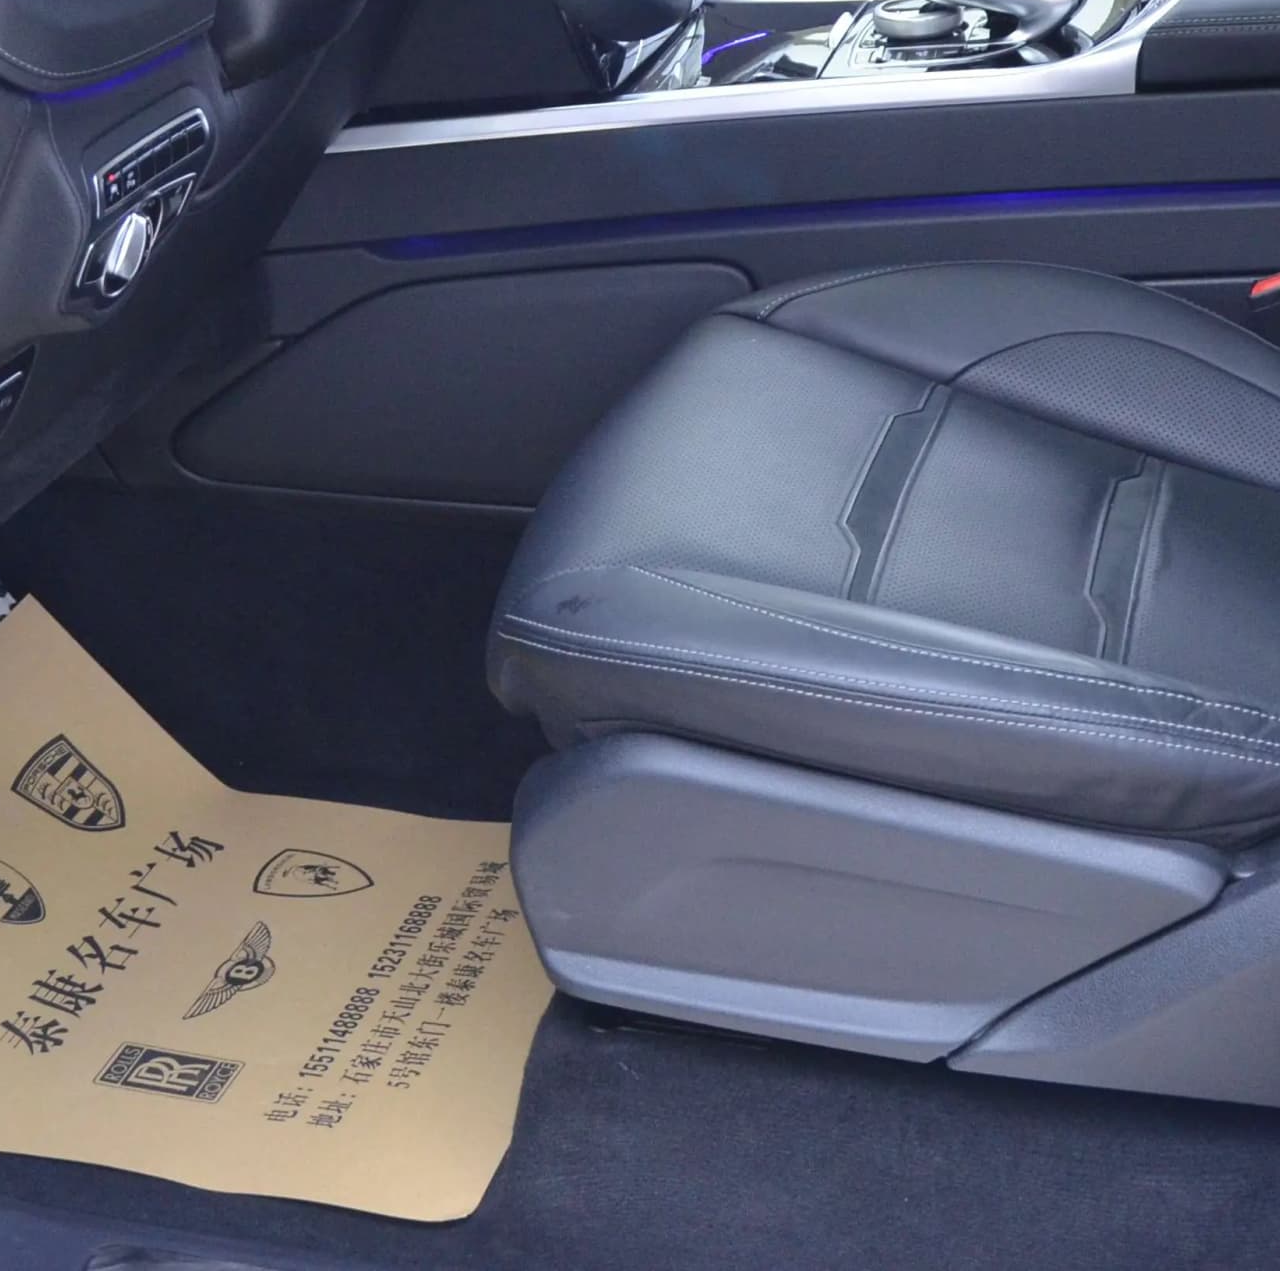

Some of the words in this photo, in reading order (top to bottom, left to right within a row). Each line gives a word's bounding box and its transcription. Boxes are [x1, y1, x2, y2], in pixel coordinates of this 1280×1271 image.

[367, 894, 443, 979] 15231168888
[387, 907, 520, 1089] 5号馆东门一楼泰康名车广场
[104, 1047, 141, 1082] ROLLS
[199, 1062, 238, 1100] ROYCE
